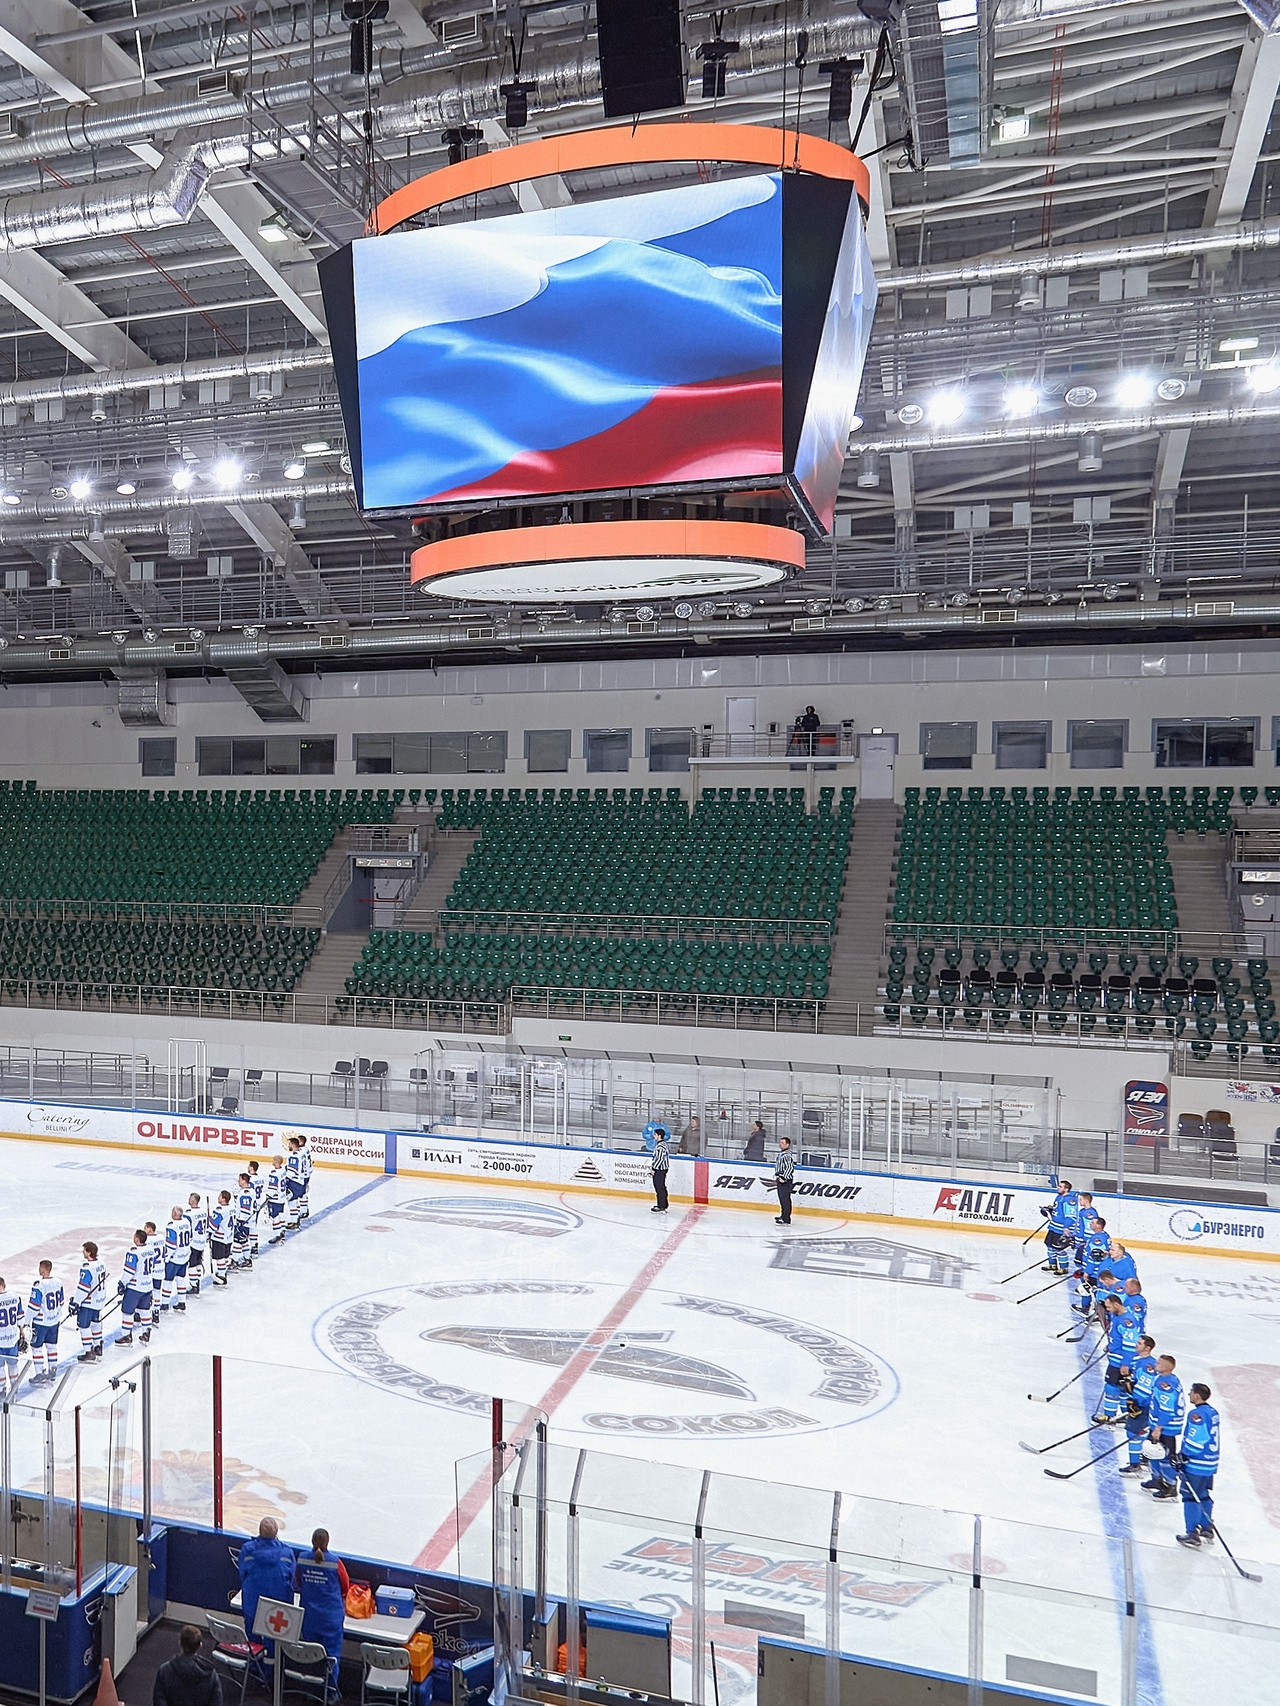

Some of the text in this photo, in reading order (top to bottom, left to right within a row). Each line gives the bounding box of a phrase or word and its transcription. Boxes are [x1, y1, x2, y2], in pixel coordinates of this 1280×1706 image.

[27, 1107, 92, 1133] Catering
[45, 1124, 68, 1133] BELLINI
[137, 1121, 274, 1149] OLIMPBET
[310, 1136, 363, 1148] ФЕДЕРАЦИЯ
[310, 1145, 385, 1159] ХОККЕЯ РОССИИ
[424, 1152, 462, 1165] ИЛАН
[482, 1160, 533, 1173] 2-000-007
[614, 1177, 646, 1185] КОМБИНАТ
[791, 1179, 862, 1200] СОКОЛ!
[959, 1189, 1015, 1216] АГАТ
[958, 1212, 1015, 1223] АВТОХОЛДИНГ
[1203, 1220, 1265, 1239] БУРЭНЕРГО
[179, 1230, 190, 1248] 10
[1122, 1331, 1134, 1340] 24
[328, 1300, 493, 1414] КРАСНОЯРСК
[661, 1296, 882, 1407] КРАСНОЯРСК
[1138, 1375, 1152, 1386] 99
[583, 1406, 822, 1435] СОКОЛ
[622, 1537, 947, 1607] РЫСИ
